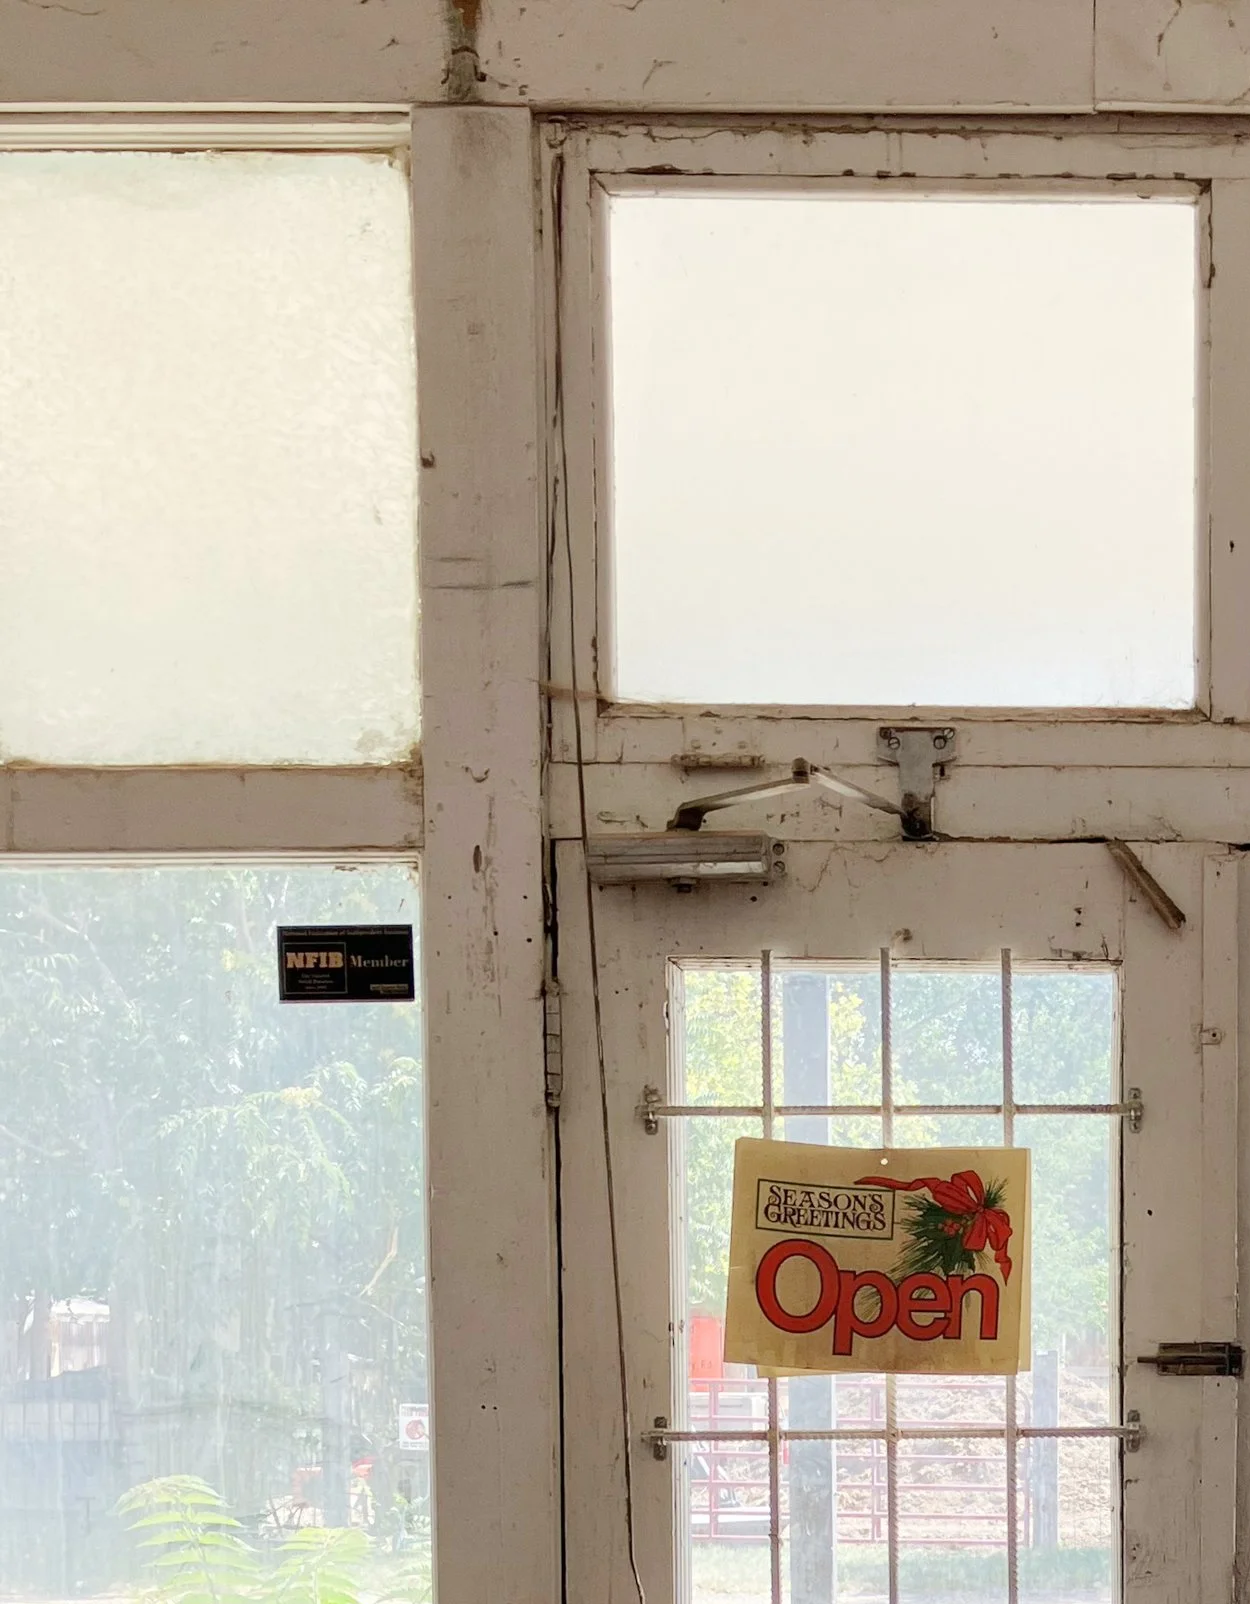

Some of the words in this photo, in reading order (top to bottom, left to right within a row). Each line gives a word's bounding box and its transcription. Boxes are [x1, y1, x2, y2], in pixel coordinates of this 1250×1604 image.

[285, 951, 344, 969] NFIB
[350, 955, 409, 968] Member
[768, 1185, 885, 1214] SEASON'S
[763, 1204, 887, 1232] GREETINGS
[755, 1238, 1000, 1356] Open
